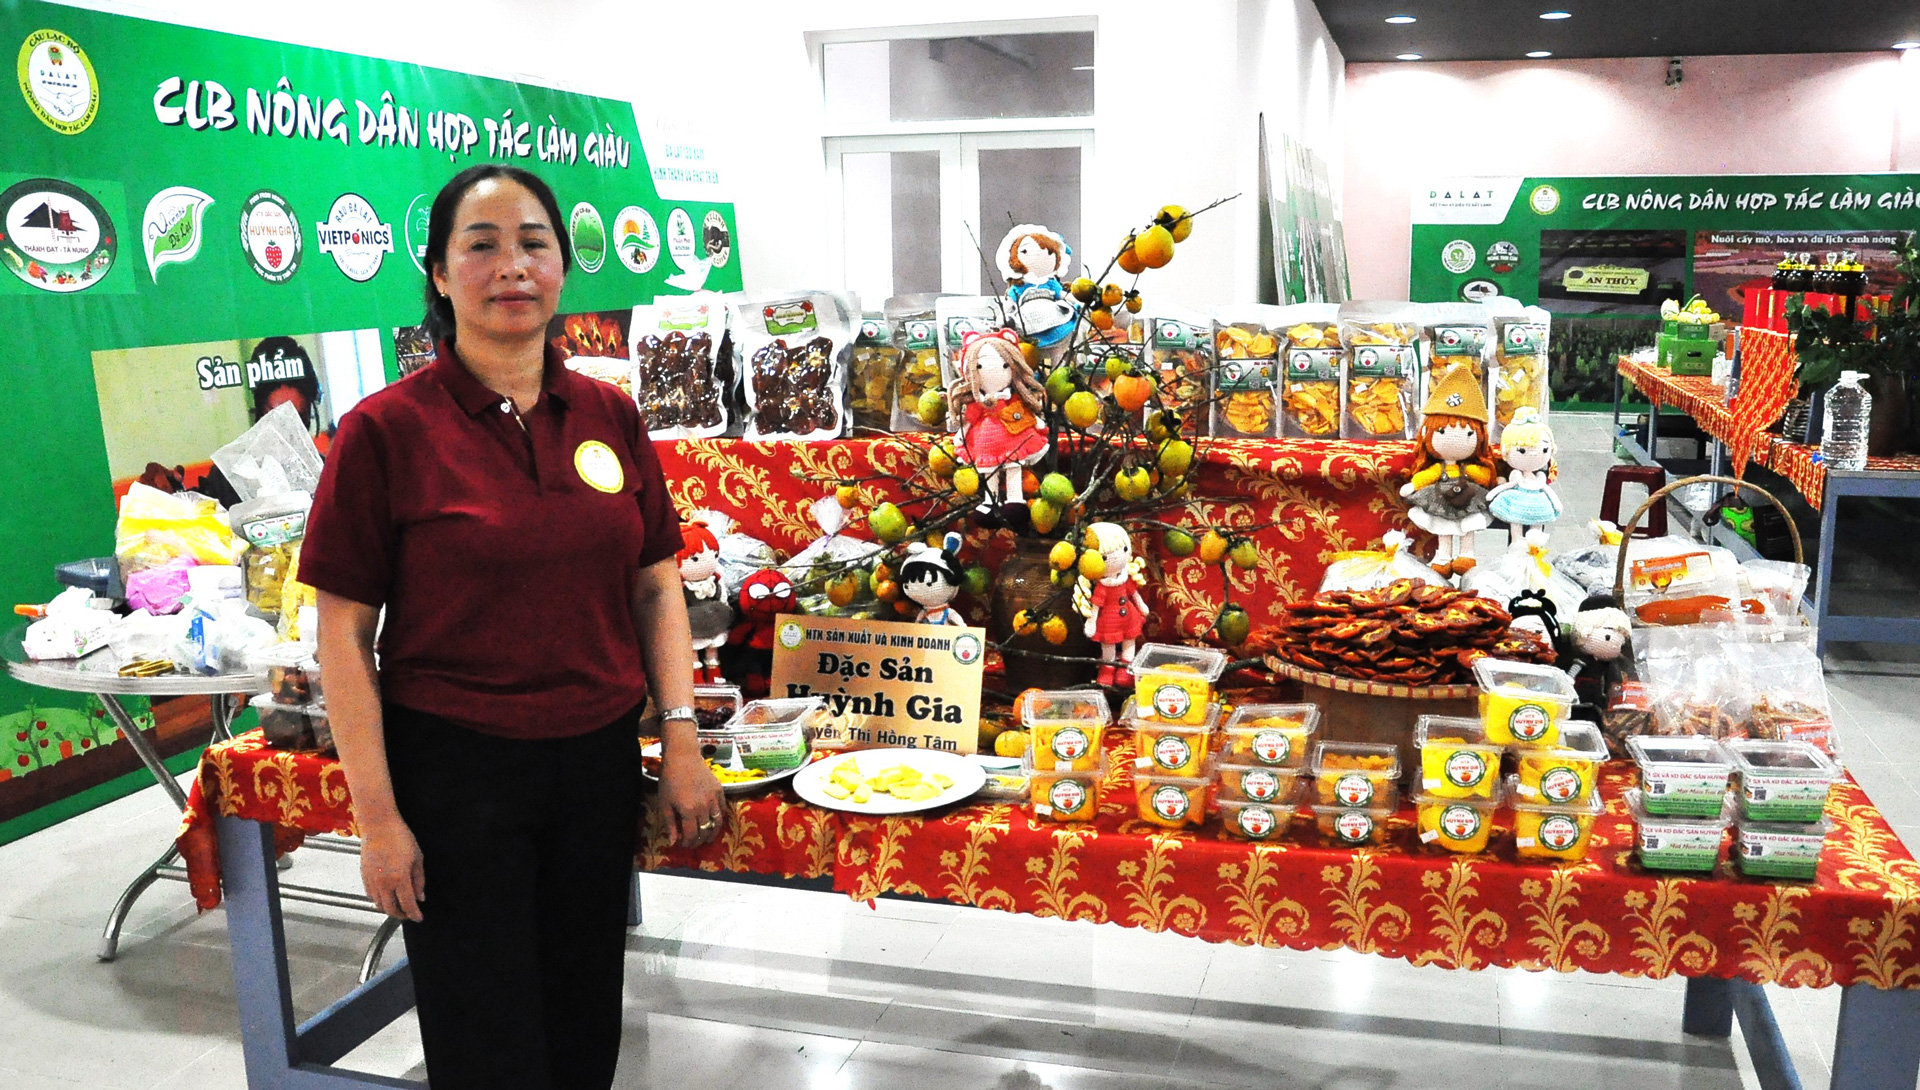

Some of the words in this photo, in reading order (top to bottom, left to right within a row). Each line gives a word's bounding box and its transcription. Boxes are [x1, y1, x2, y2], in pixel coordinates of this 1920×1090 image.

[153, 76, 236, 131] CLB
[246, 76, 349, 146] NÔNG
[355, 90, 419, 148] DÂN
[427, 110, 479, 163] HỢP
[483, 108, 532, 158] TÁC
[537, 114, 577, 167] LÀM
[584, 123, 630, 169] GIÀU
[1582, 193, 1620, 210] CLB
[1626, 188, 1683, 211] NÔNG
[1689, 188, 1731, 210] DÂN
[1735, 192, 1778, 214] HỢP
[1784, 187, 1824, 210] TÁC
[1830, 186, 1871, 210] LÀM
[1711, 234, 1734, 244] Nuôi
[1737, 234, 1752, 246] cấy
[1776, 234, 1795, 244] hoa
[1797, 235, 1809, 244] và
[1811, 234, 1824, 244] du
[1826, 234, 1844, 246] lịch
[1847, 234, 1870, 244] canh
[1872, 235, 1897, 246] nông
[197, 357, 242, 389] Sản
[246, 348, 305, 389] phẩm
[805, 628, 823, 641] HTX
[826, 627, 845, 642] SẢN
[847, 629, 871, 645] XUẤT
[874, 633, 887, 646] VÀ
[890, 635, 914, 648] KINH
[917, 637, 951, 651] DOANH
[817, 652, 871, 683] Đặc
[879, 656, 934, 684] Sản
[906, 694, 963, 724] Gia
[849, 727, 871, 744] Thị
[877, 729, 916, 749] Hồng
[923, 734, 958, 751] Tâm
